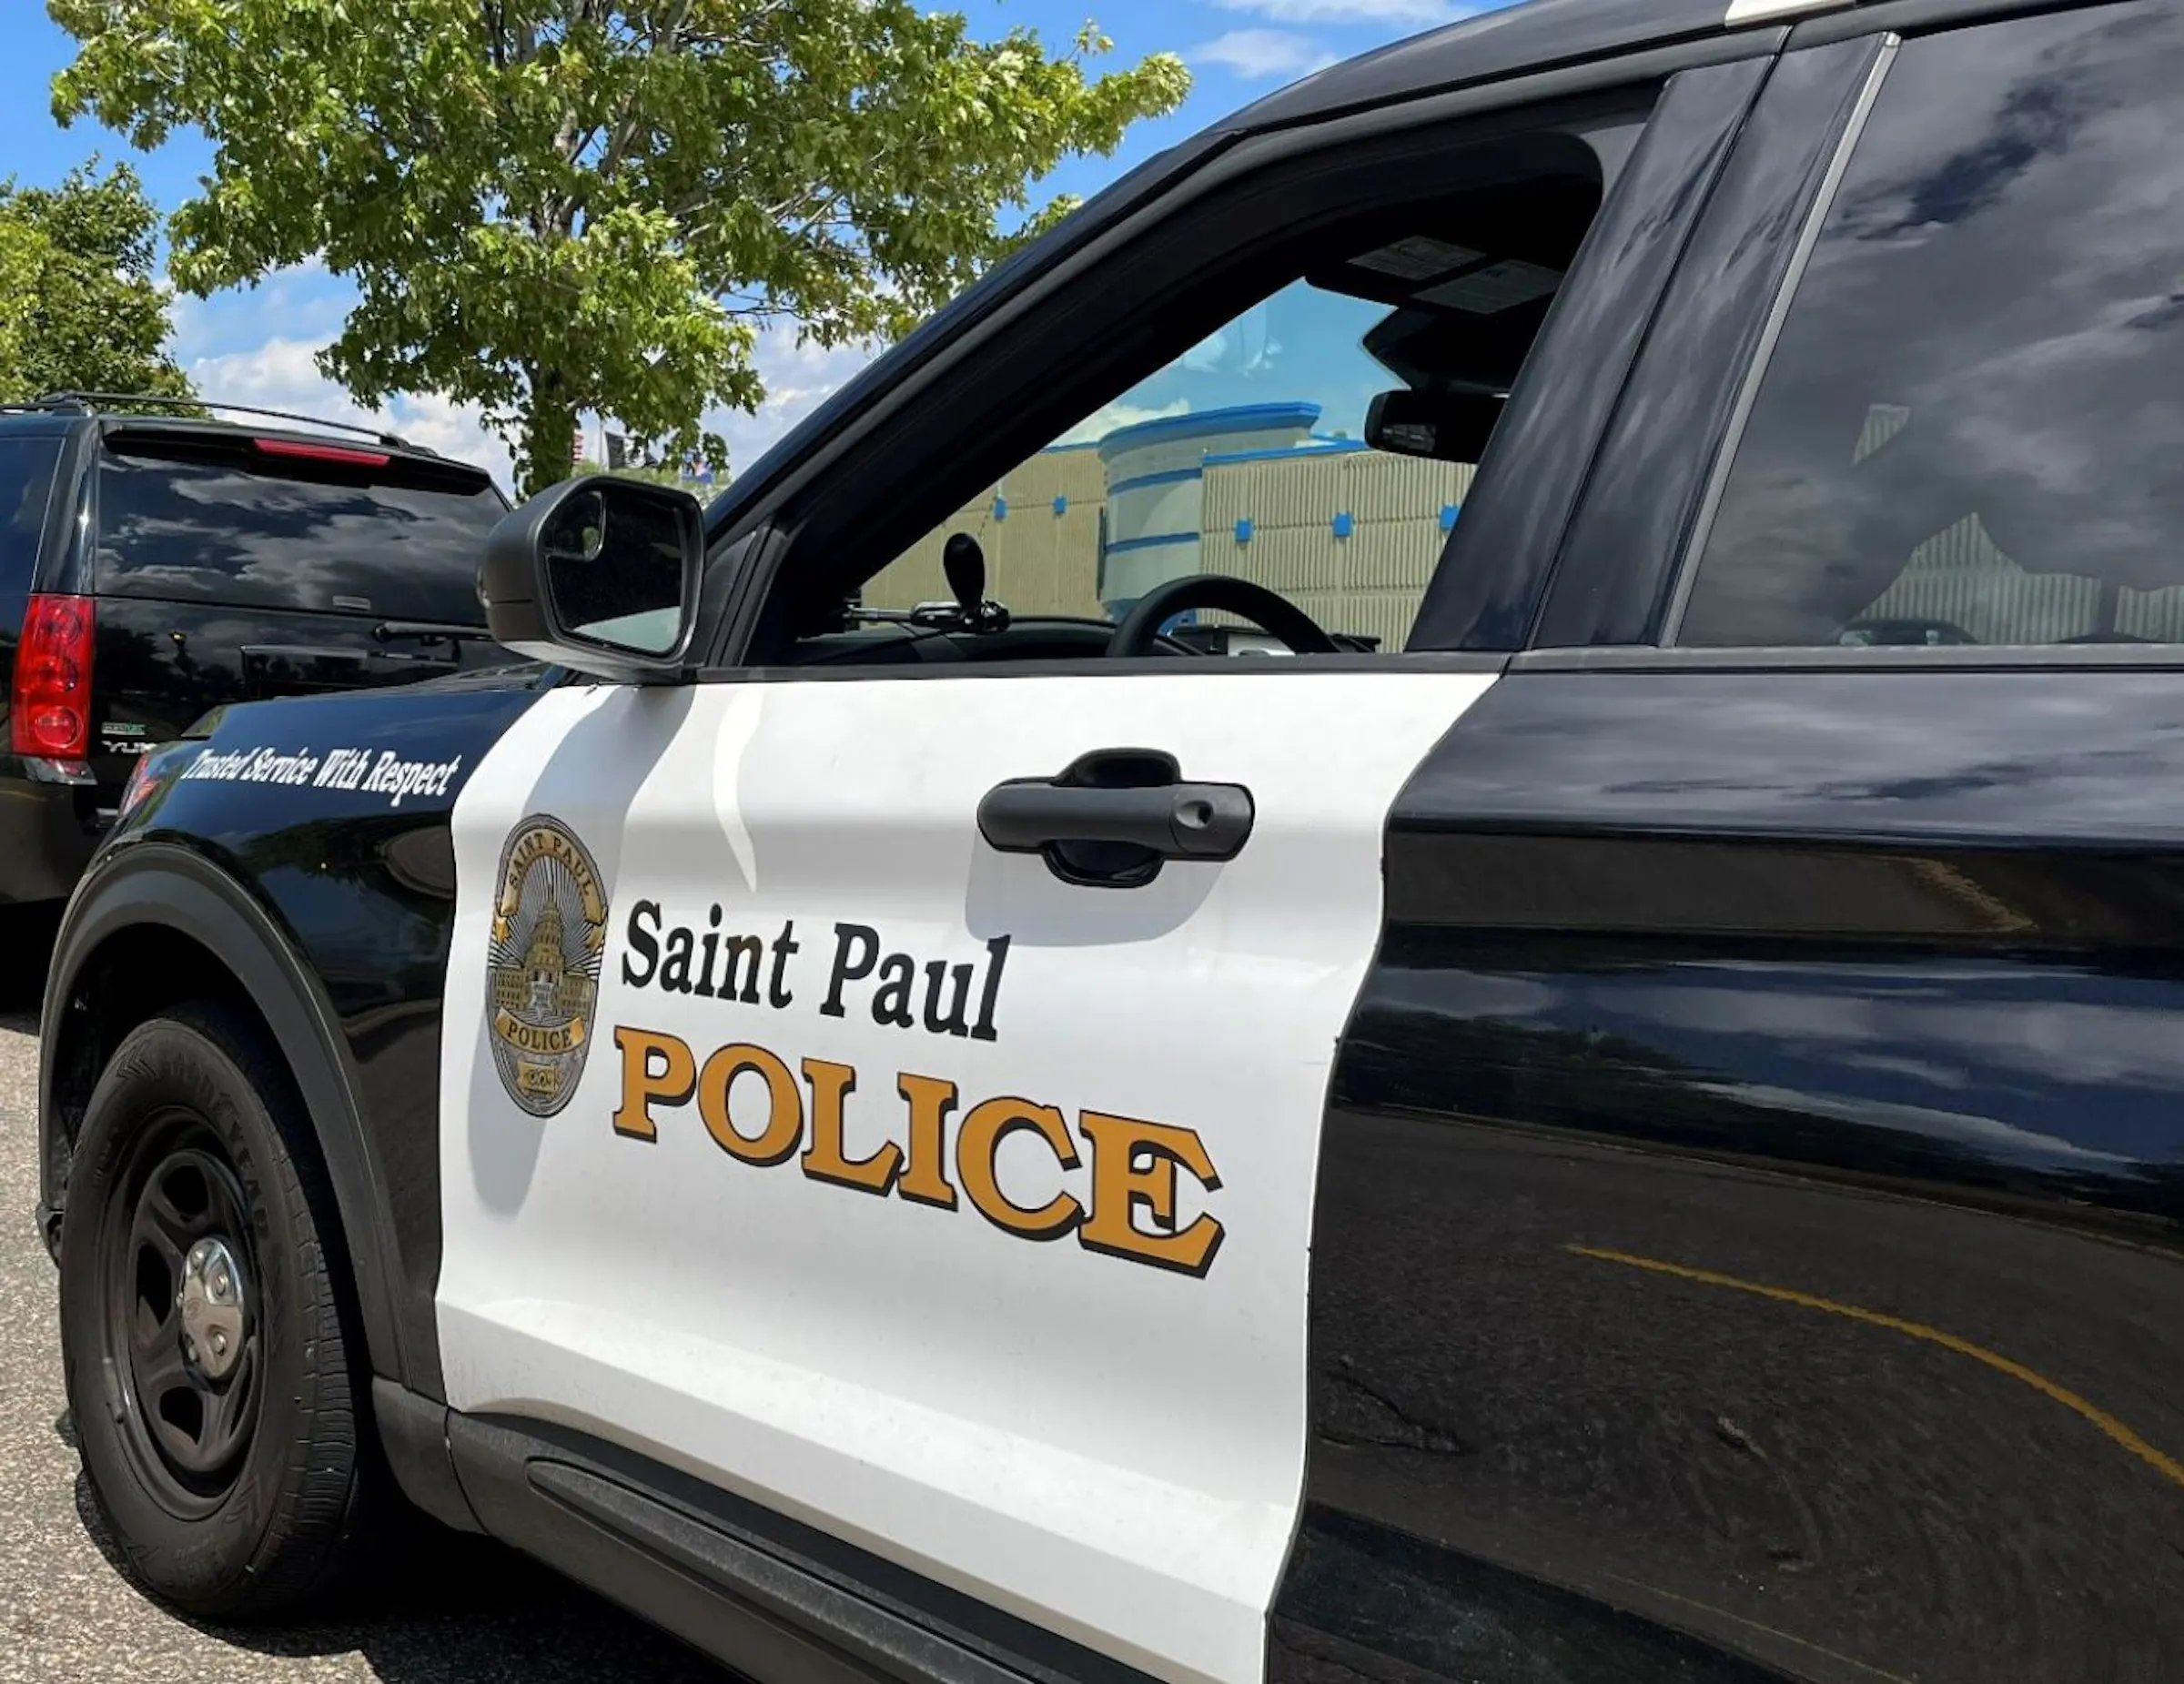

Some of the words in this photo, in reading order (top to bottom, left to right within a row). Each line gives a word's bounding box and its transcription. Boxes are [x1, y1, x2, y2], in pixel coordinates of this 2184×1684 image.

[179, 747, 261, 780] Trusted
[238, 746, 318, 785] Service
[311, 747, 372, 790] With
[361, 750, 462, 808] Respect
[508, 832, 543, 890] SAINT
[552, 836, 592, 895] PAUL
[621, 898, 800, 1010] Saint
[819, 922, 1013, 1042] Paul
[507, 1020, 573, 1052] POLICE
[612, 1024, 1227, 1280] POLICE
